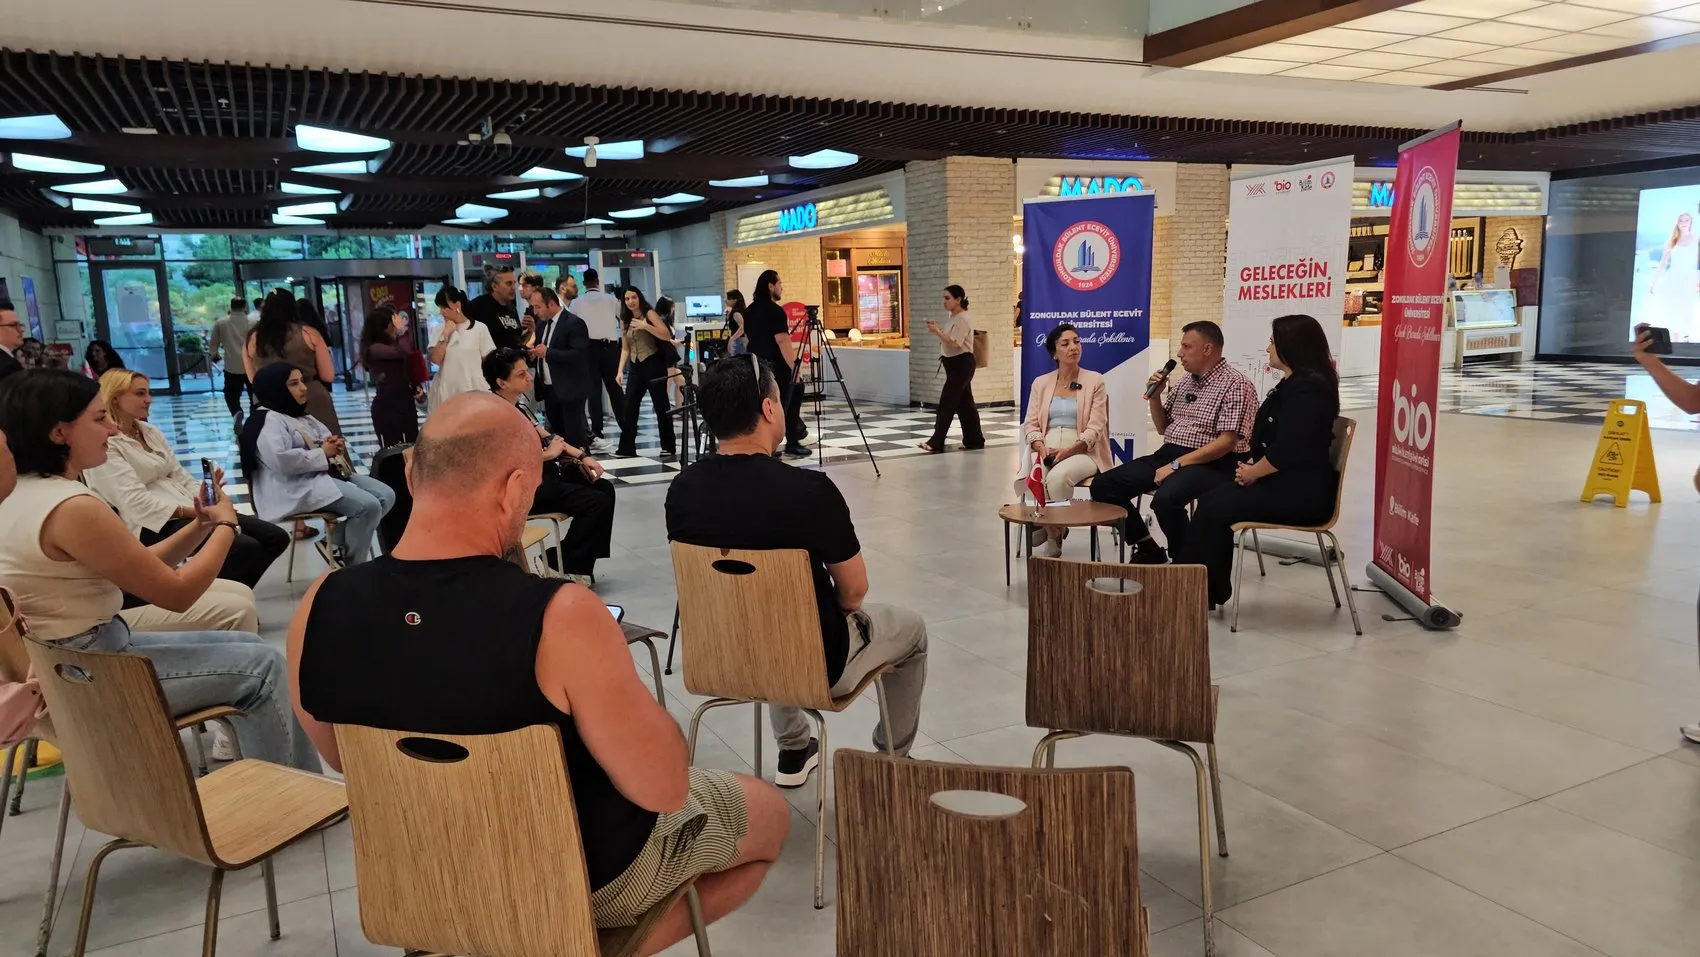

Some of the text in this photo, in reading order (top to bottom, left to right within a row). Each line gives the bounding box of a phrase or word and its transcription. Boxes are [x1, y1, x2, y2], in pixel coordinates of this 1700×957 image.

[1060, 175, 1142, 197] MADO
[778, 203, 817, 233] MADO
[1240, 257, 1328, 282] GELECEĞİN
[1238, 276, 1332, 301] MESLEKLERİ
[1030, 308, 1143, 319] ZONGULDAK BÜLENT ECEVİT
[1393, 379, 1432, 451] bio
